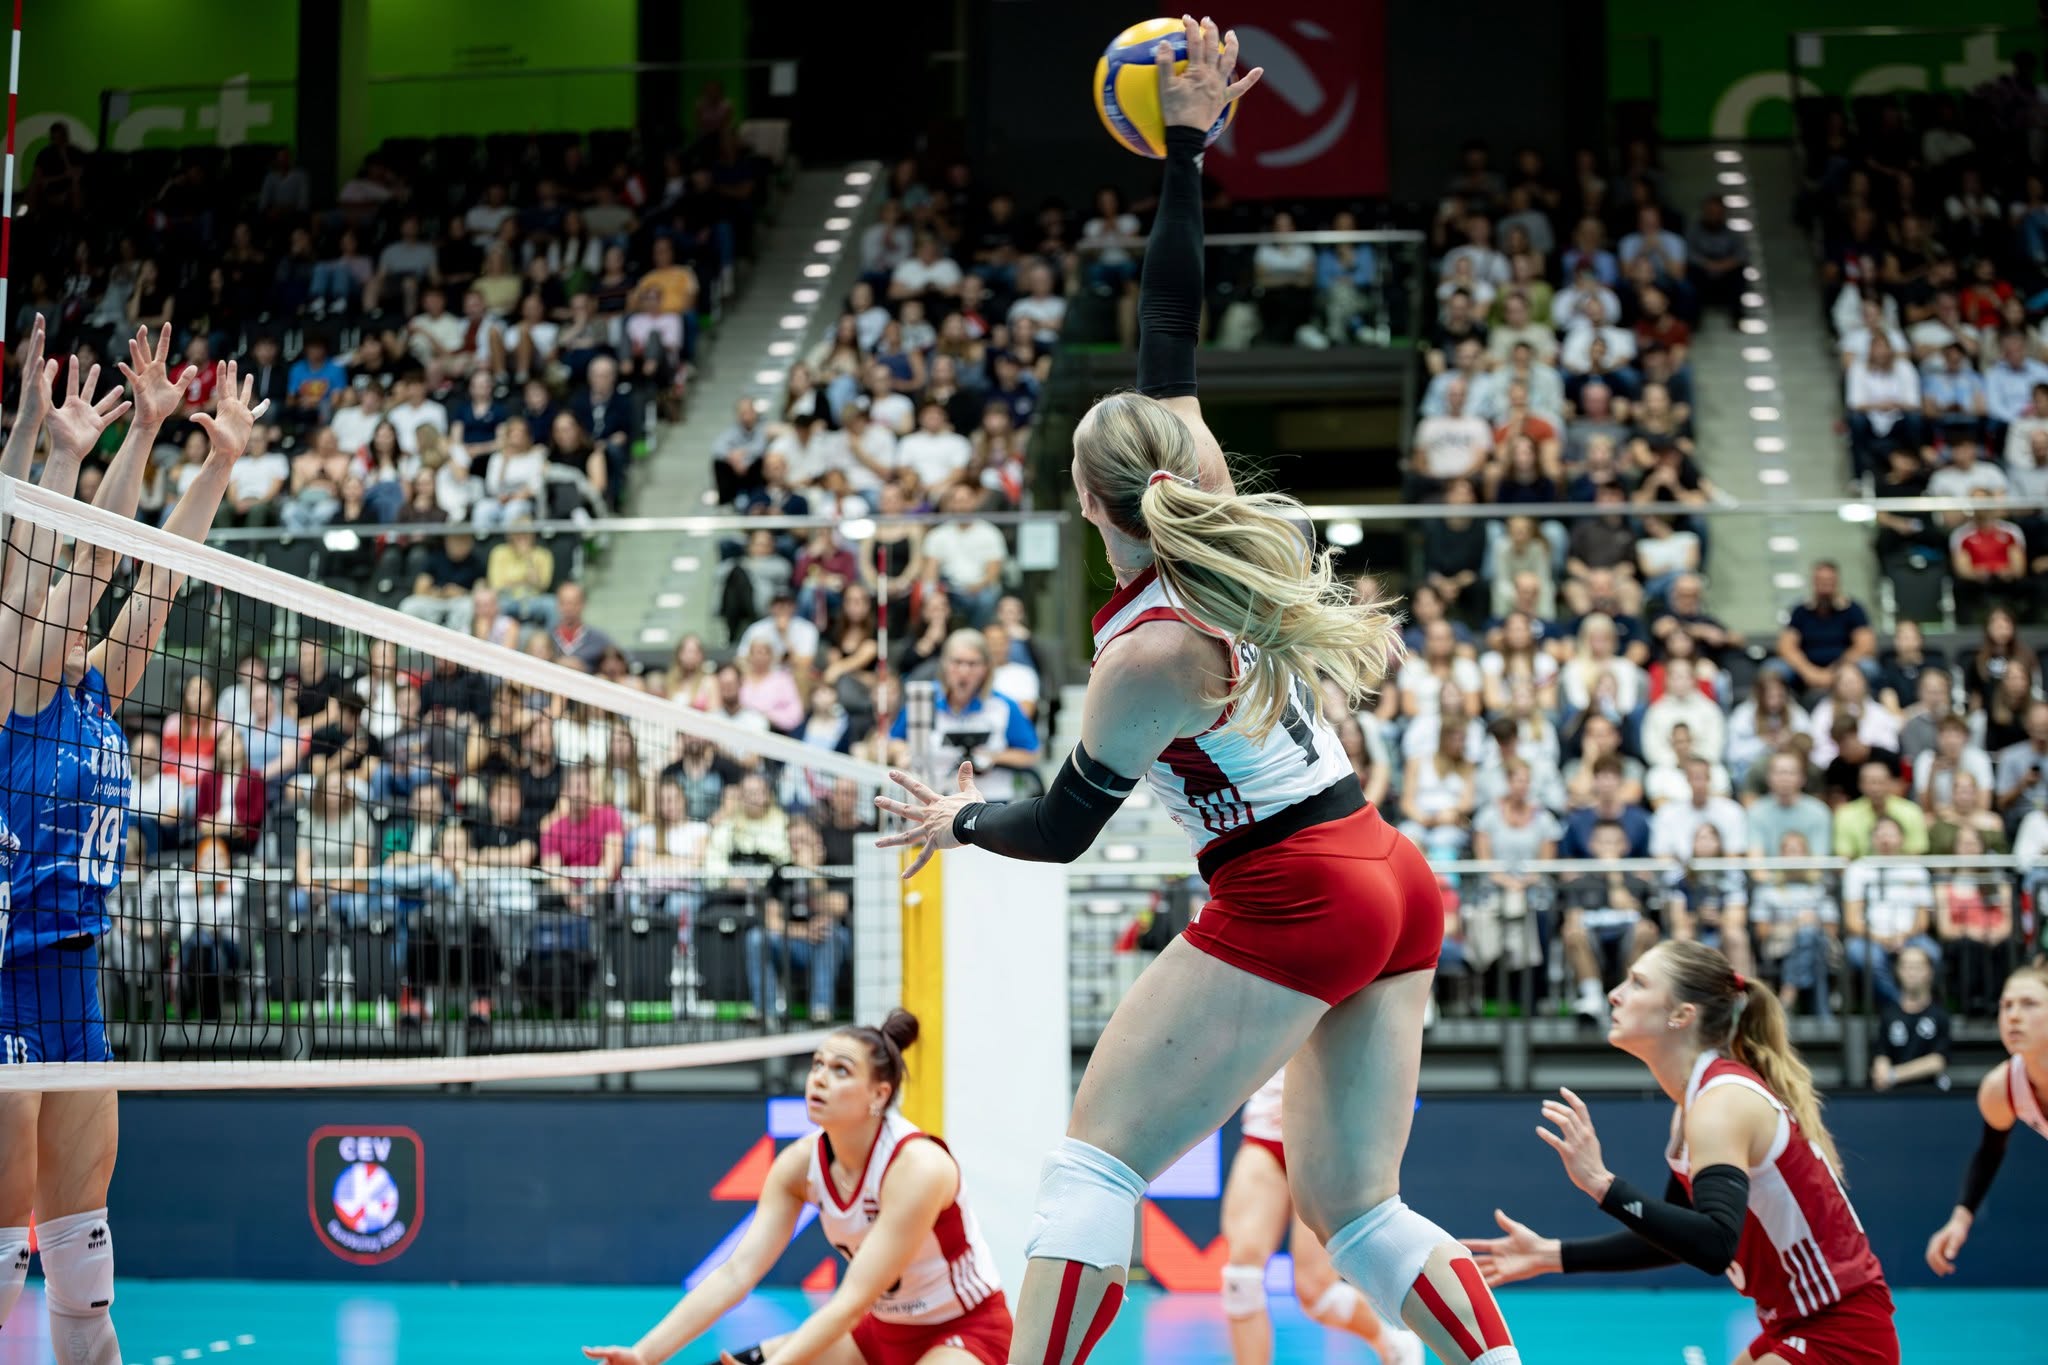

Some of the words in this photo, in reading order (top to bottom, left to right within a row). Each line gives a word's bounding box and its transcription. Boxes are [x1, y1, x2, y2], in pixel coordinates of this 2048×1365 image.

[79, 803, 123, 885] 19
[339, 1136, 391, 1162] CEV
[14, 1262, 28, 1270] erre
